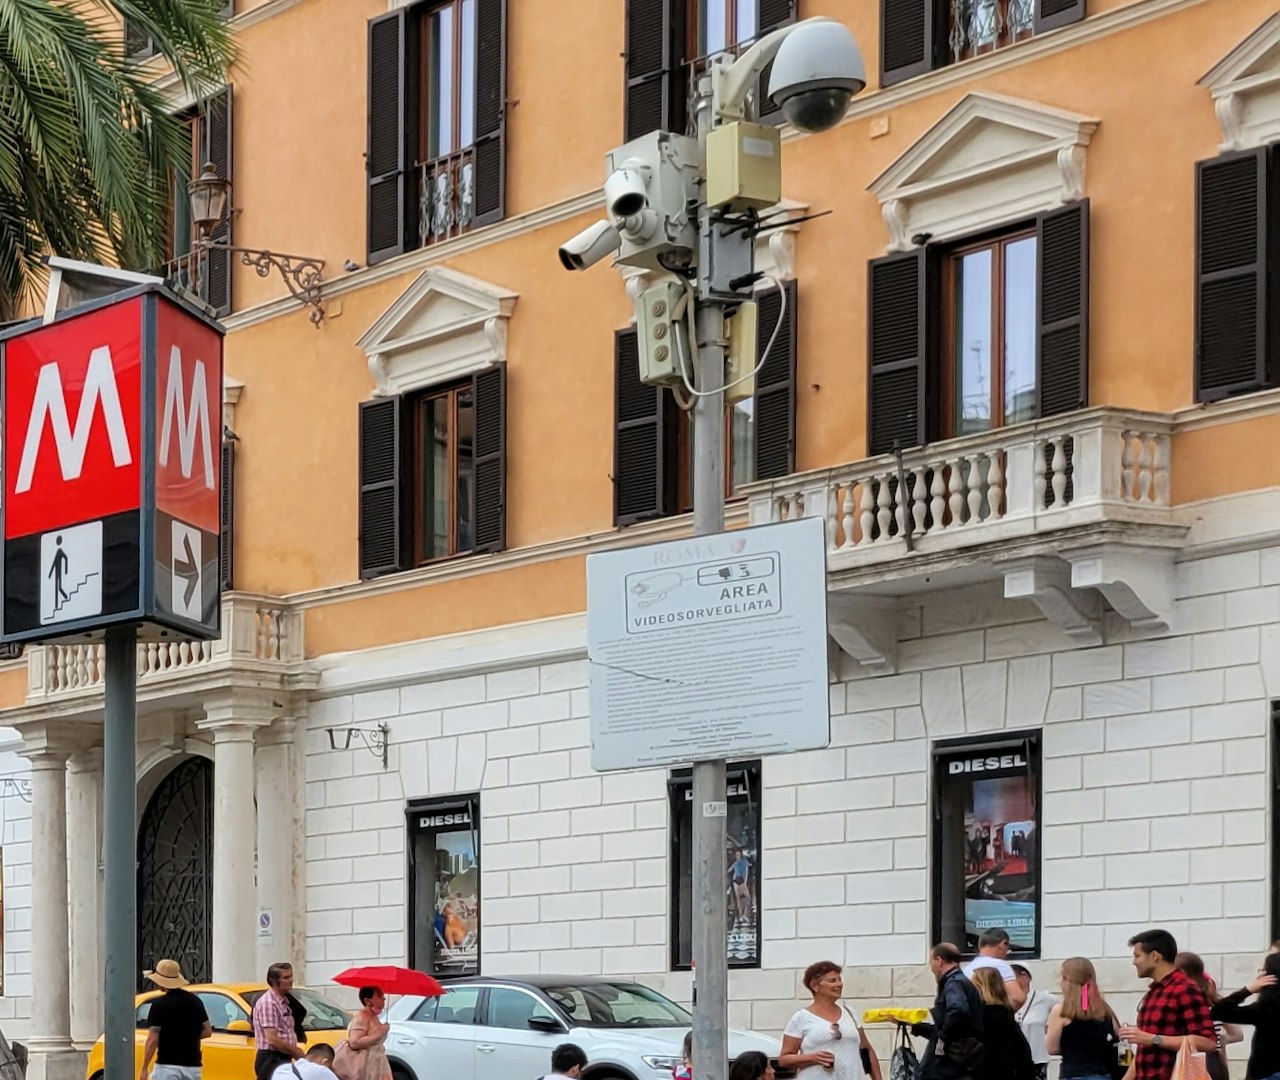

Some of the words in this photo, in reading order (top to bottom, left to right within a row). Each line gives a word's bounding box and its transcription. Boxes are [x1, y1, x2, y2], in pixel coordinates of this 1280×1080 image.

[14, 344, 133, 495] M
[158, 344, 215, 491] M
[653, 543, 716, 566] ROMA
[719, 581, 769, 601] AREA
[633, 598, 774, 628] VIDEOSORVEGLIATA
[948, 753, 1027, 775] DIESEL
[684, 783, 749, 801] DEL
[419, 812, 471, 828] DIESEL
